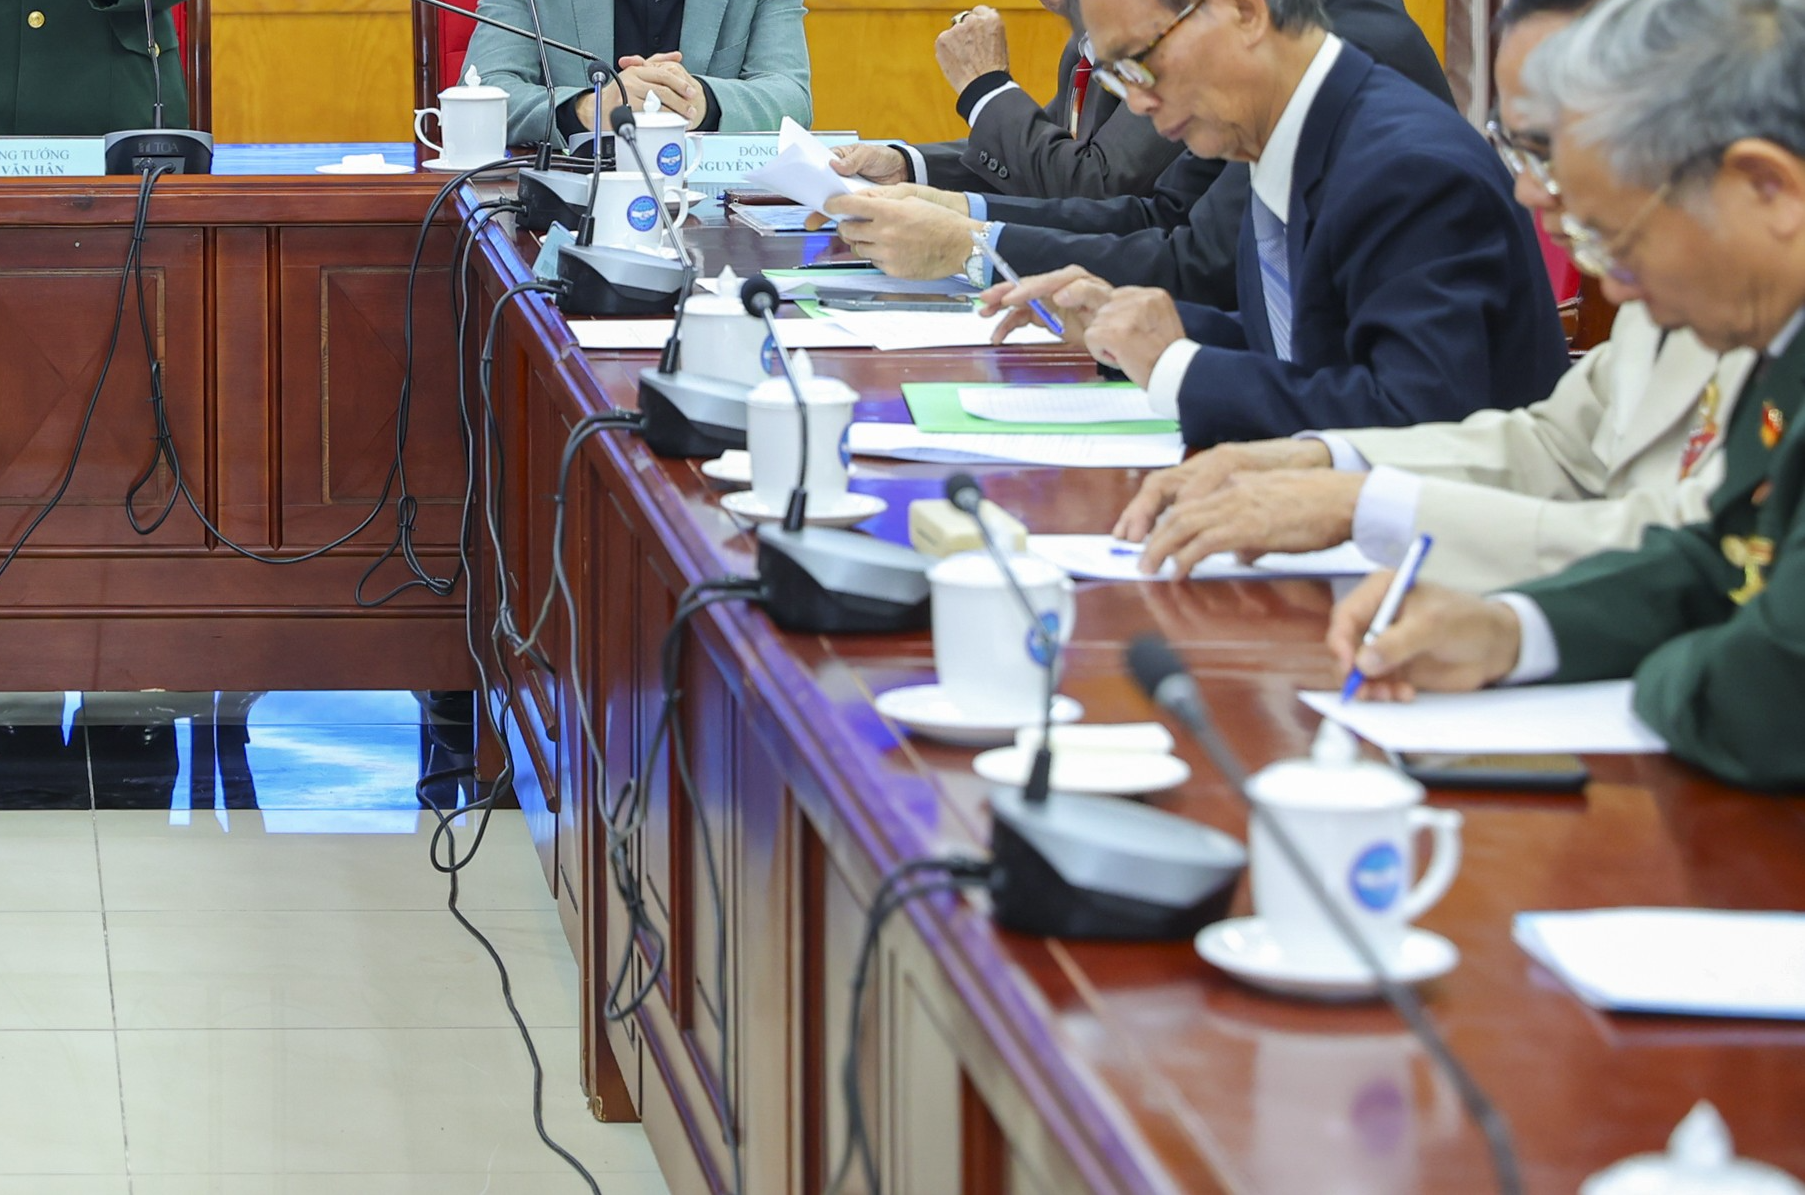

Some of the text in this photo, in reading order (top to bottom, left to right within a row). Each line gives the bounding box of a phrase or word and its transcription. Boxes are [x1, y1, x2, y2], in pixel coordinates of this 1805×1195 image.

[21, 147, 70, 161] TƯỚNG
[1, 163, 31, 175] VĂN
[35, 162, 65, 175] HÂN
